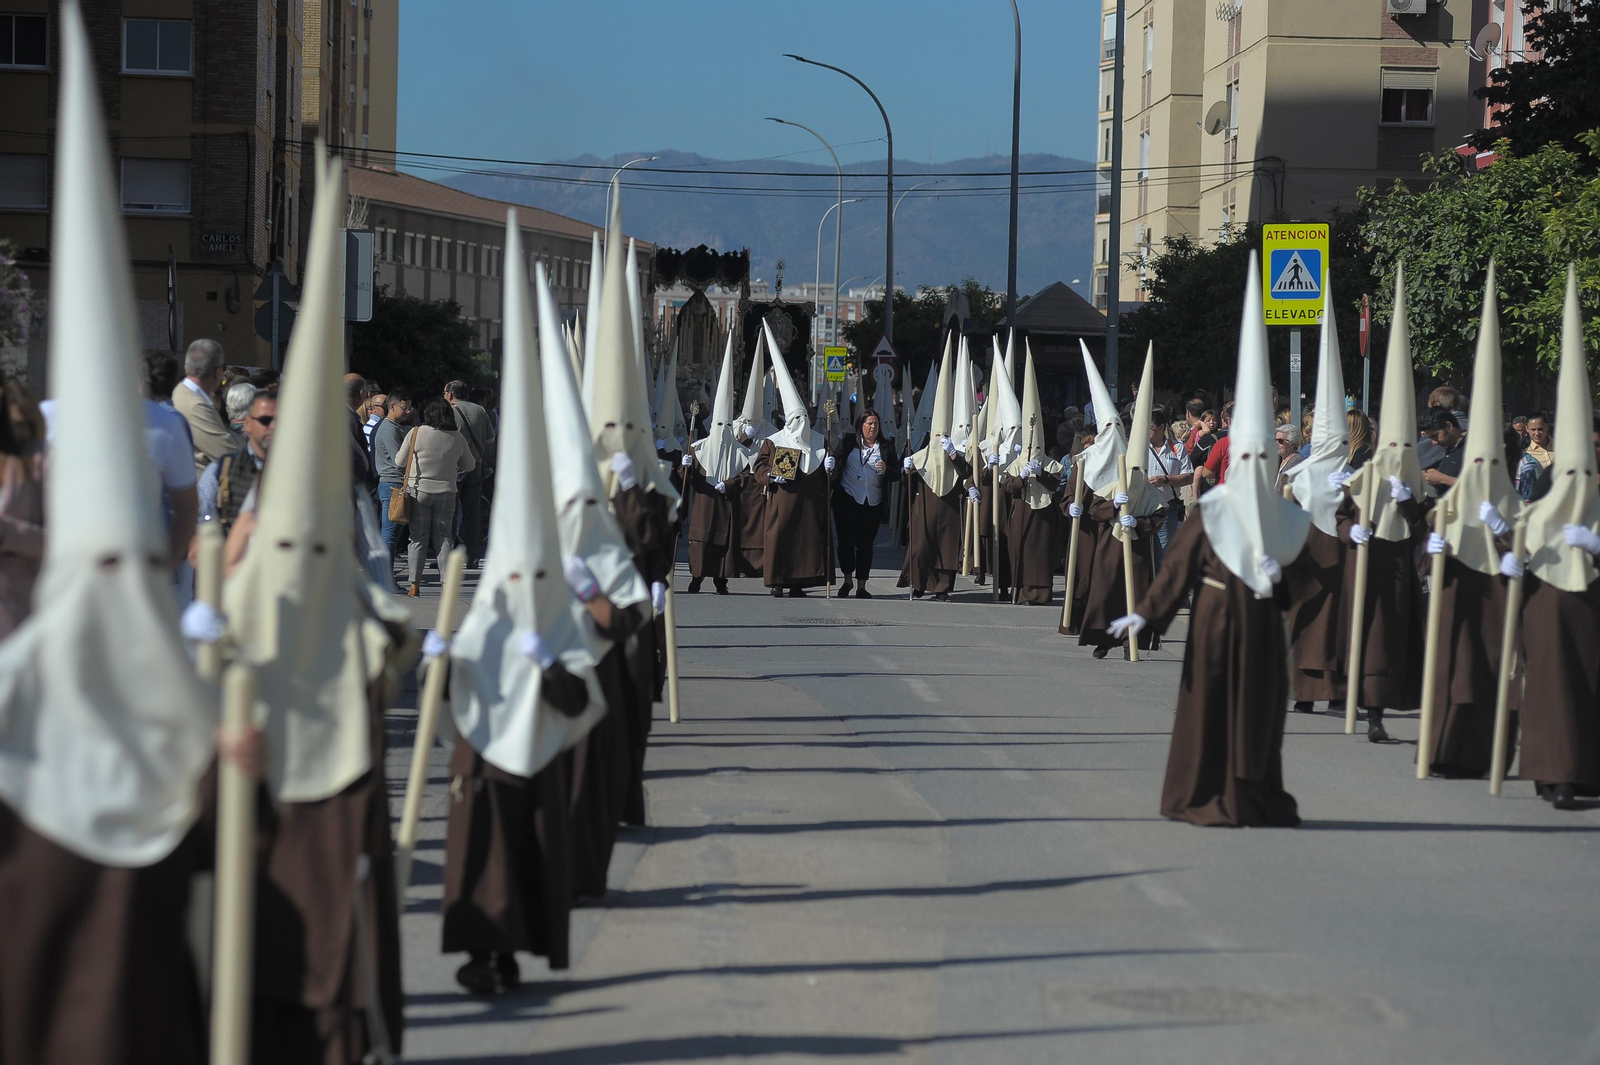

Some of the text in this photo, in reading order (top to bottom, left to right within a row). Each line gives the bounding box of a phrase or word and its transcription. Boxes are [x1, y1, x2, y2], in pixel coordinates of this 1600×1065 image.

[202, 234, 242, 243] CARLOS
[1265, 229, 1327, 240] ATENCION
[209, 244, 235, 252] AMEL
[1044, 346, 1081, 354] GOLOSINAS
